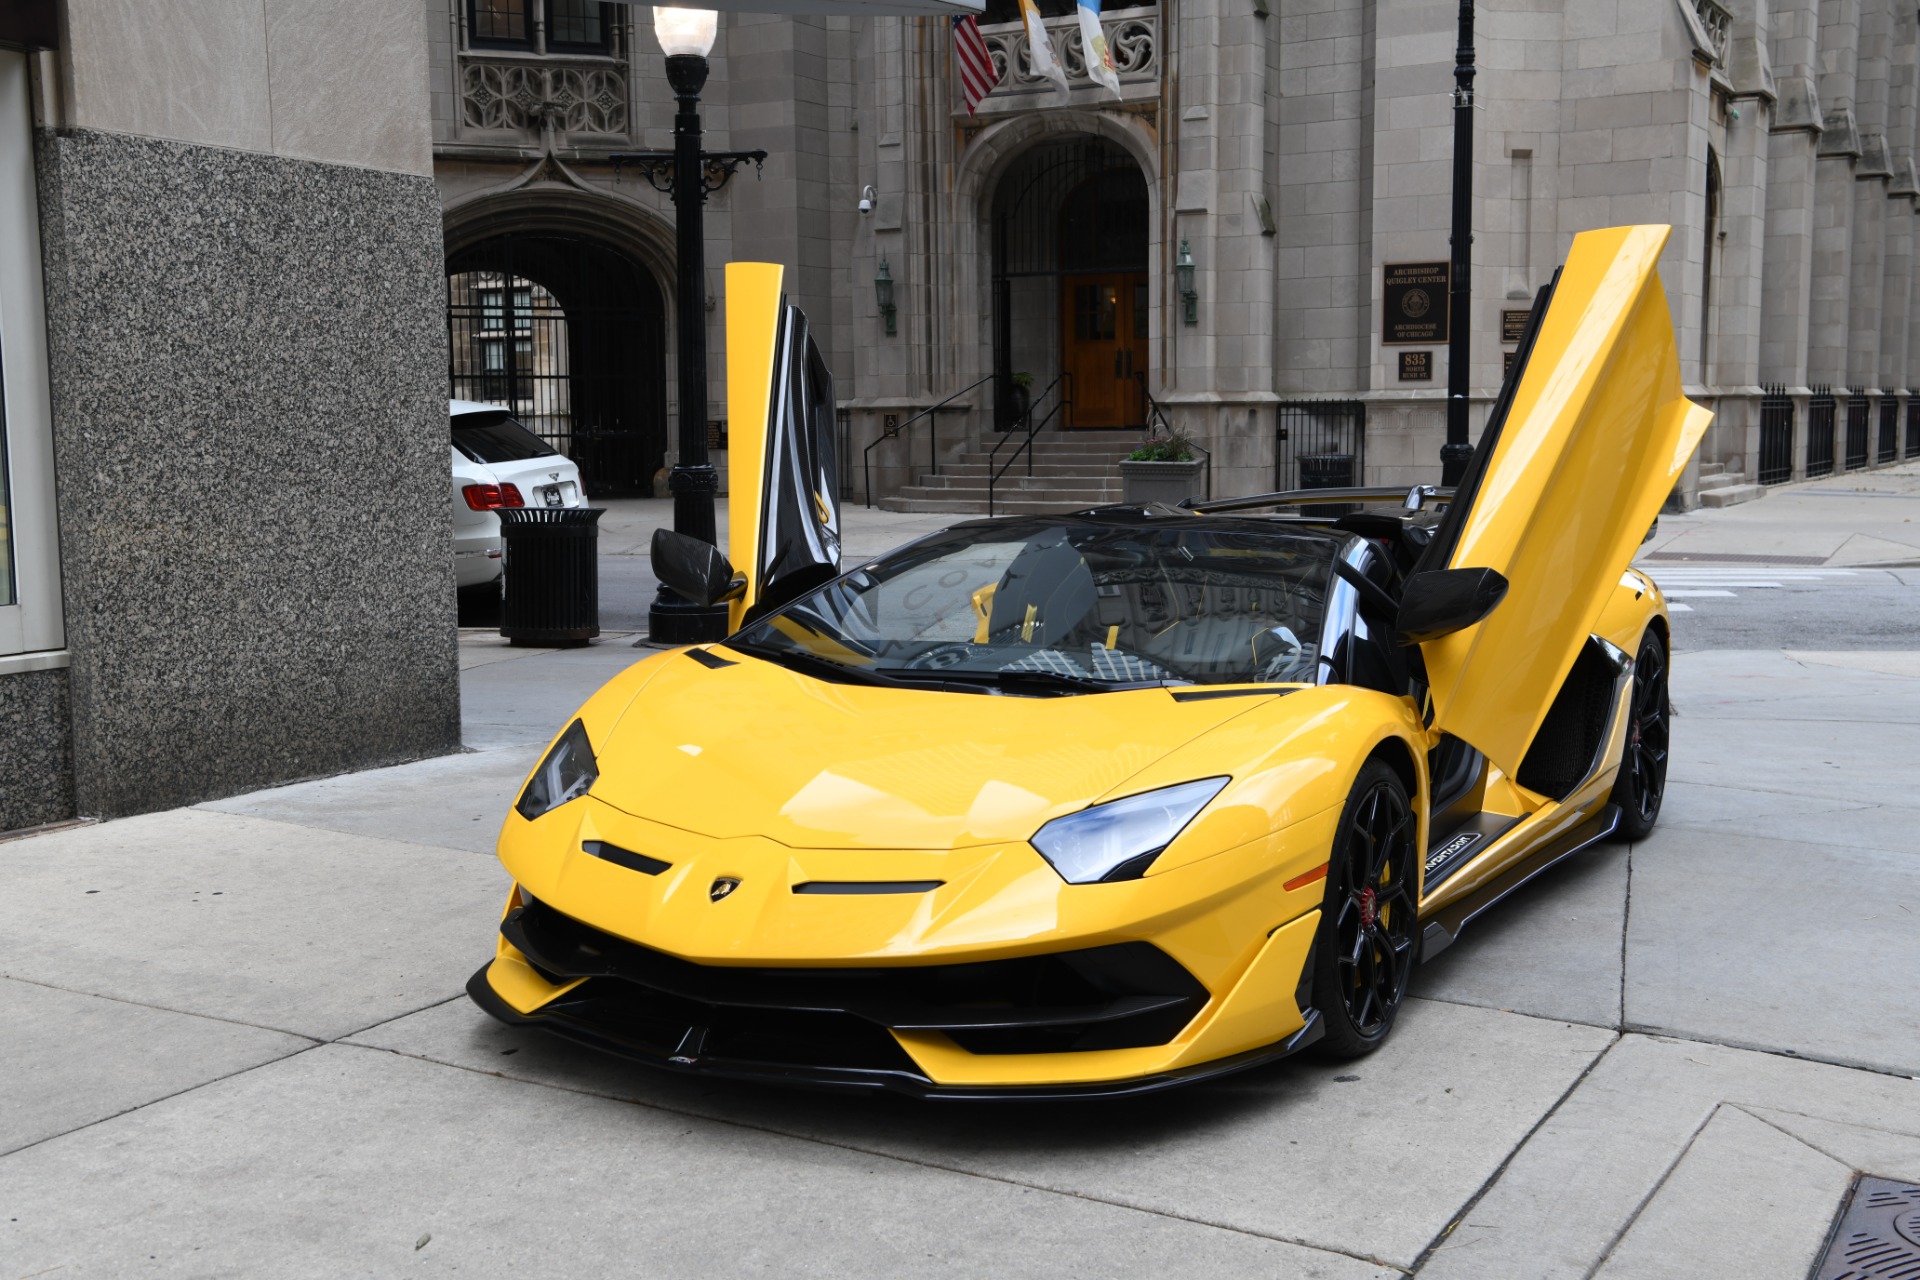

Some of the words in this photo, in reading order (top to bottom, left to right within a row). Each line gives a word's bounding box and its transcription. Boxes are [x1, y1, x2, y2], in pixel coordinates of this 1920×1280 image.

[1394, 267, 1439, 276] ARCHBISHOP
[1386, 276, 1417, 286] QUIGLEY
[1418, 275, 1447, 284] CENTER
[1406, 330, 1434, 338] CHICAGO
[1405, 353, 1426, 366] 835
